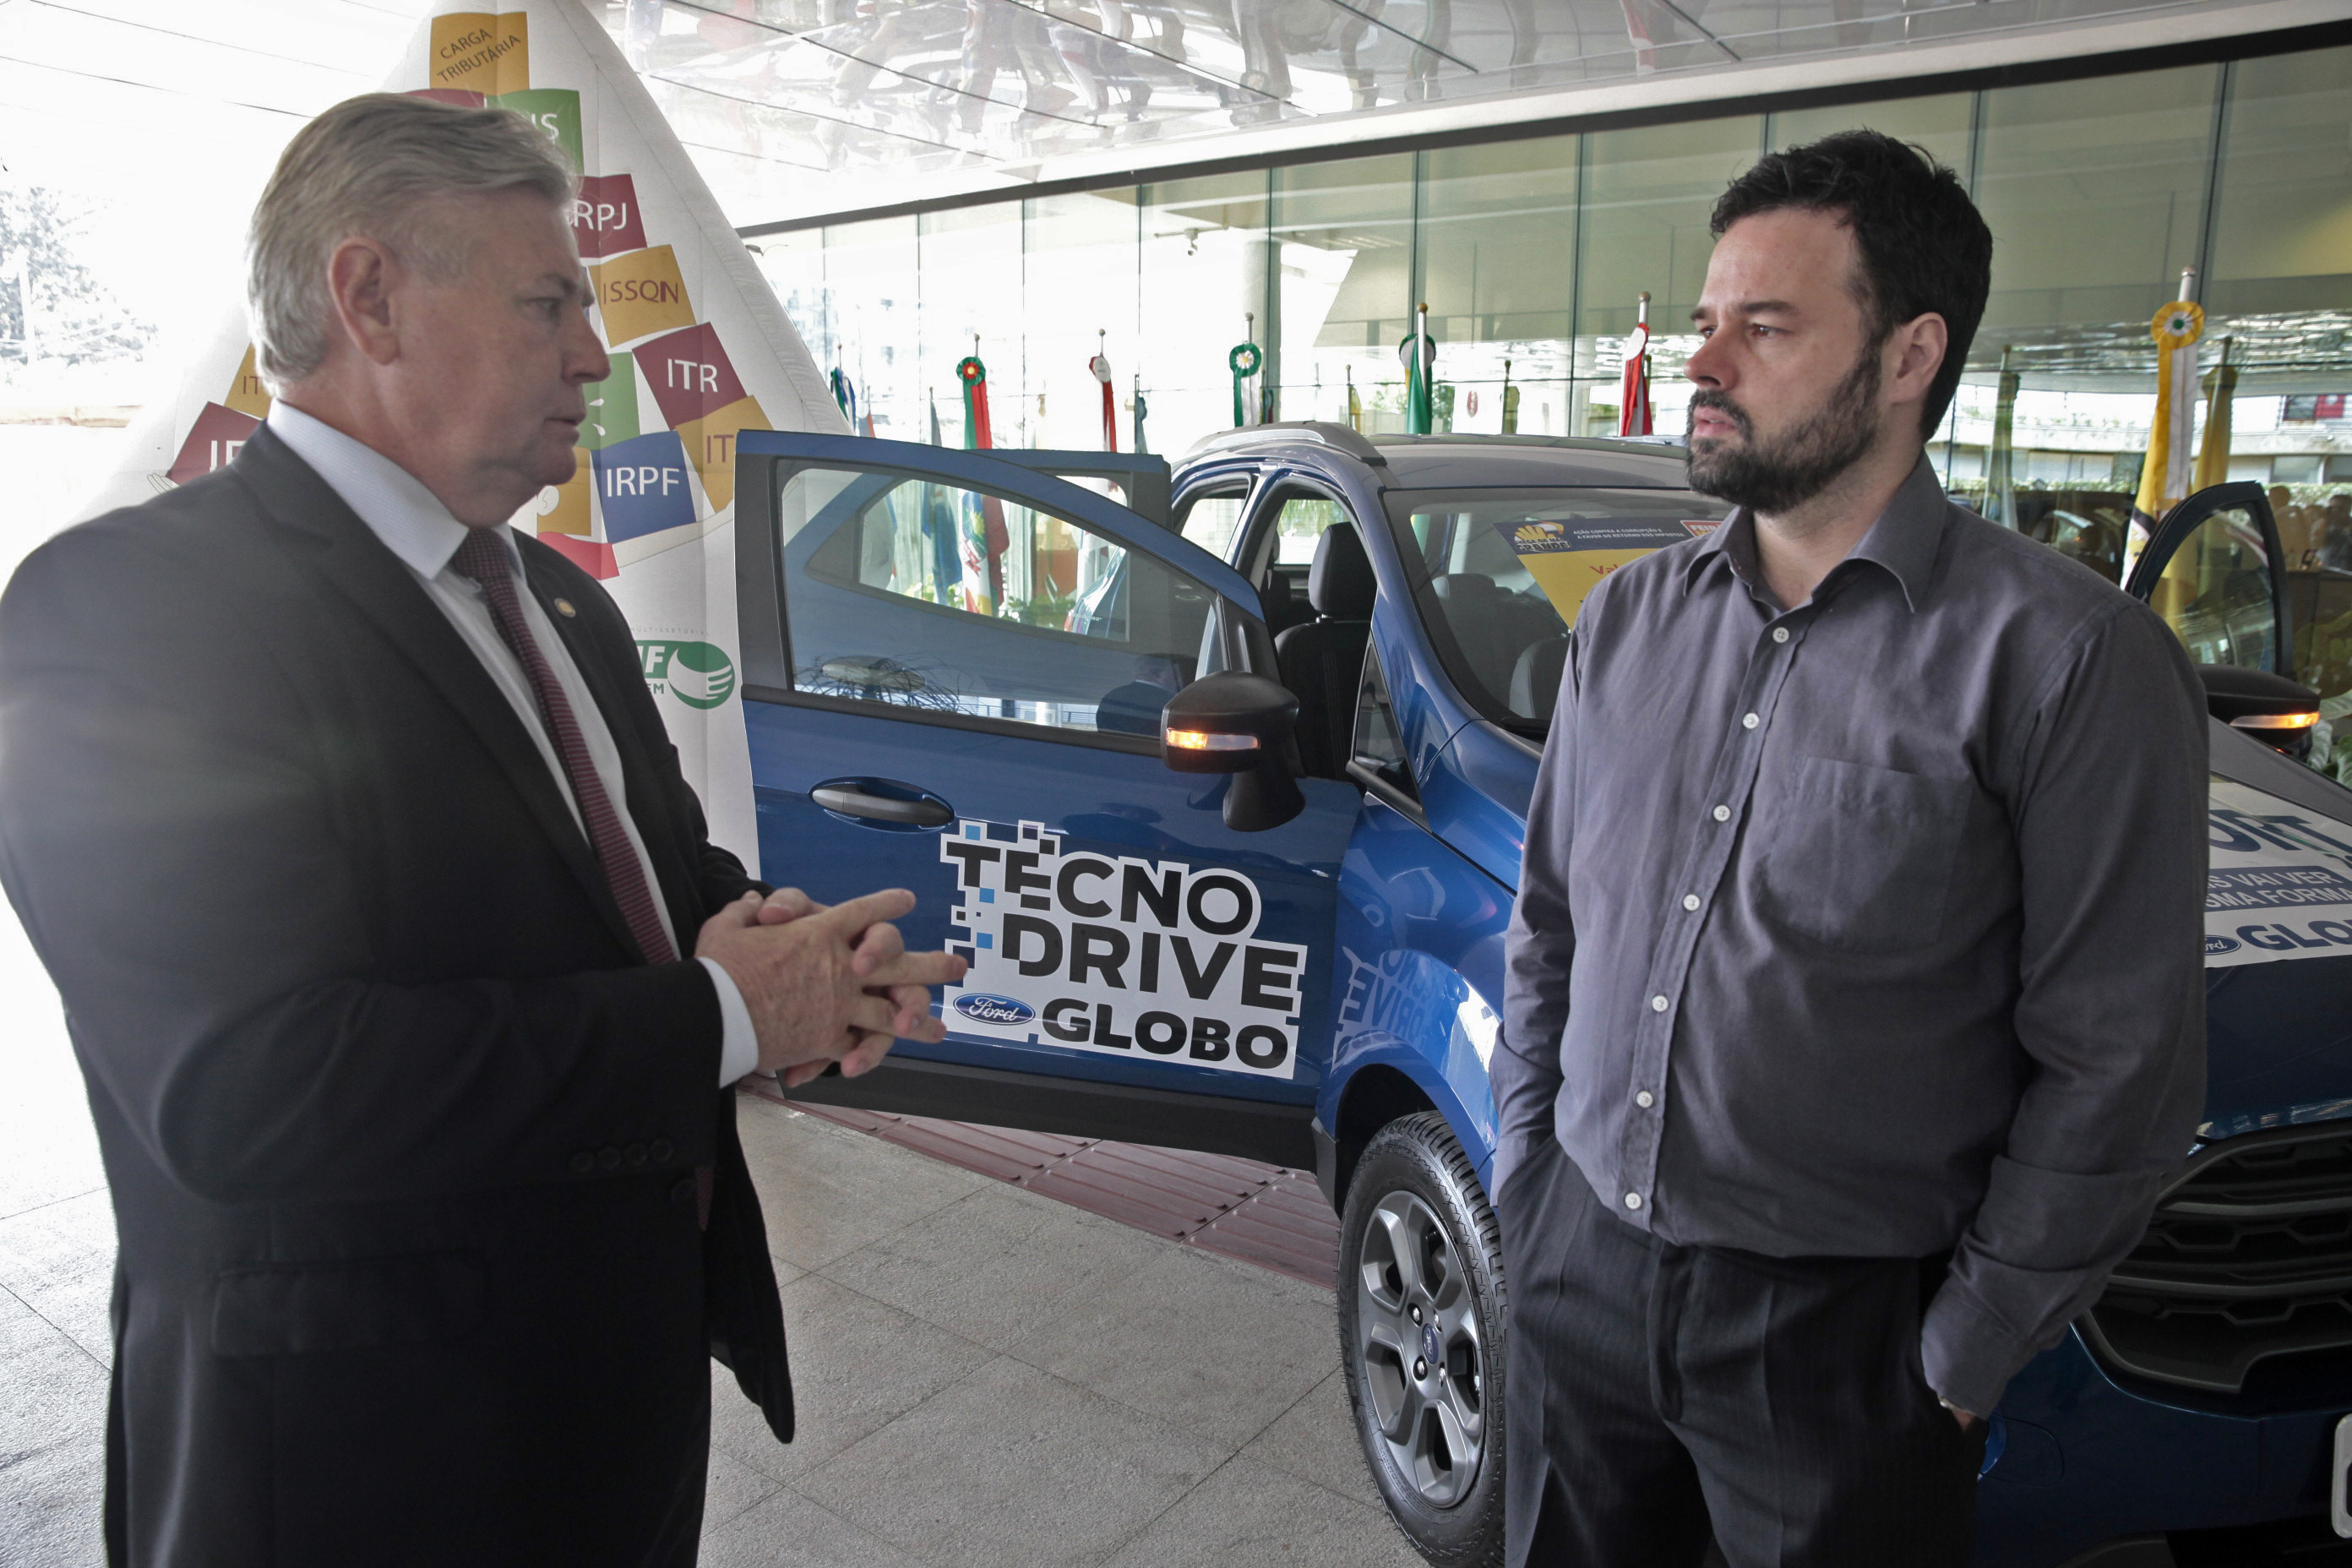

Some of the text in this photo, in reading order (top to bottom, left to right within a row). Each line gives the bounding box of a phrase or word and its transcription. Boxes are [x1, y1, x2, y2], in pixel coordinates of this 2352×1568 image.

[437, 35, 520, 82] TRIBUTÁRIA
[440, 29, 492, 60] CARGA
[531, 113, 559, 140] IS
[574, 199, 628, 232] RPJ
[603, 280, 679, 304] ISSQN
[667, 358, 718, 394] ITR
[706, 433, 735, 465] IT
[607, 466, 680, 498] IRPF
[946, 841, 1254, 936] TECNO
[2225, 873, 2284, 886] VAI
[2273, 871, 2344, 885] VER
[2235, 919, 2352, 950] GLO
[1002, 913, 1298, 1012] DRIVE
[968, 997, 1018, 1025] Ford
[1042, 998, 1288, 1070] GLOBO
